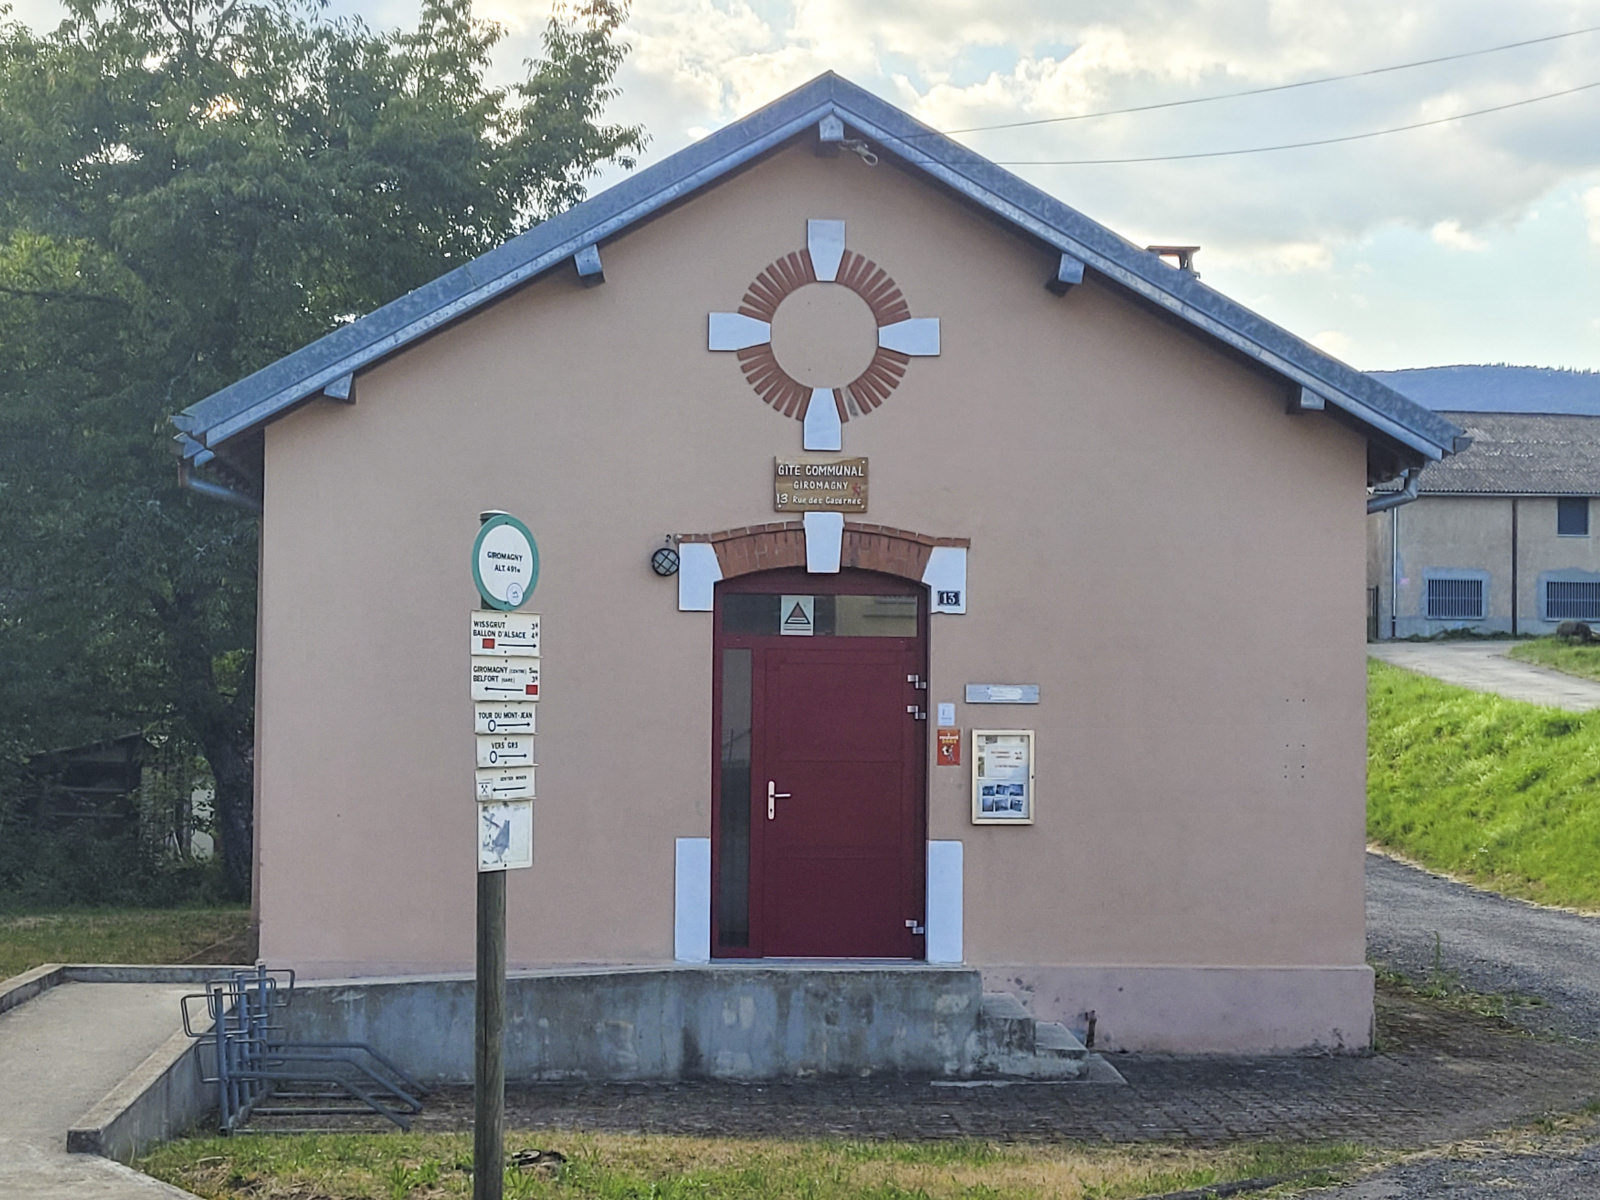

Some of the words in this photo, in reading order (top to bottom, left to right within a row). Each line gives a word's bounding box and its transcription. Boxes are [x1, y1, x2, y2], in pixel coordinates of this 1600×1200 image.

[805, 465, 864, 476] COMMUNAL
[793, 481, 848, 490] GIROMAGNY
[776, 493, 788, 504] 13
[792, 495, 806, 504] Rue
[808, 496, 823, 504] des
[825, 496, 861, 504] Casernes
[487, 551, 523, 561] GIROMAGNY
[942, 592, 956, 604] 13
[473, 620, 506, 629] WISSGRUT
[473, 629, 496, 637] BALLON
[497, 630, 526, 639] D'ALSACE
[473, 665, 508, 674] GIROMAGNY
